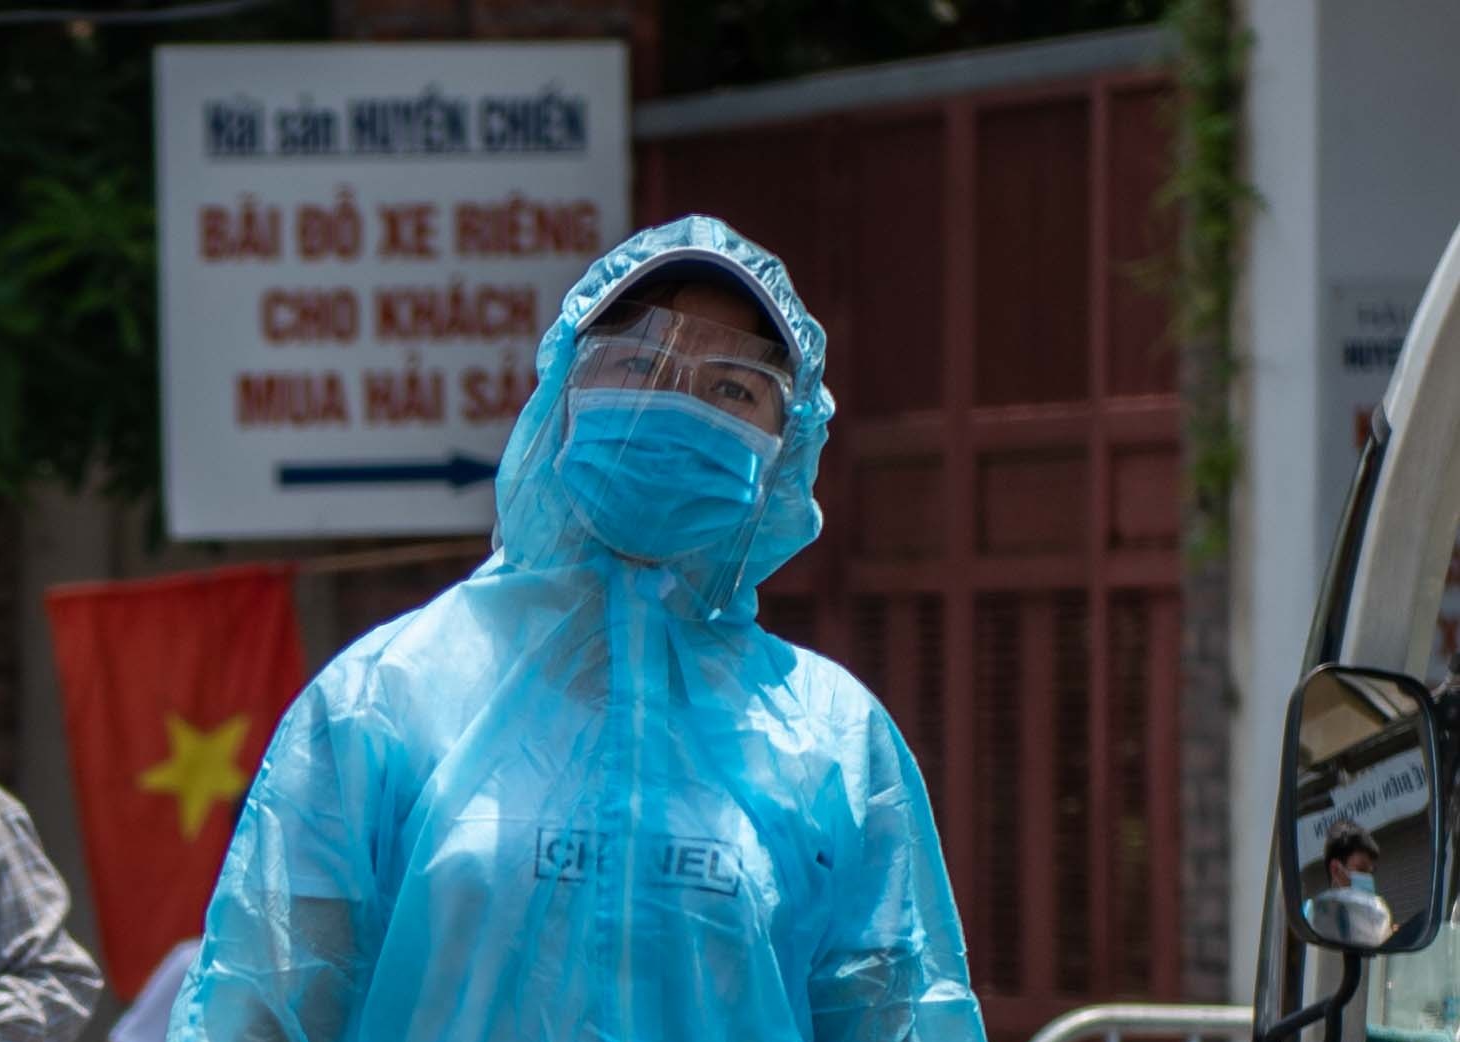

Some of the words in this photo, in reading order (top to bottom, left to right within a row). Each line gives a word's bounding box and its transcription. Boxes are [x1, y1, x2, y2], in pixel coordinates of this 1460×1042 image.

[378, 204, 436, 259] XE
[454, 189, 599, 255] RIÊNG
[263, 287, 357, 342] CHO
[376, 275, 536, 340] KHÁCH
[236, 370, 347, 426] MUA
[364, 352, 447, 423] HẢI
[462, 350, 538, 423] SẢ
